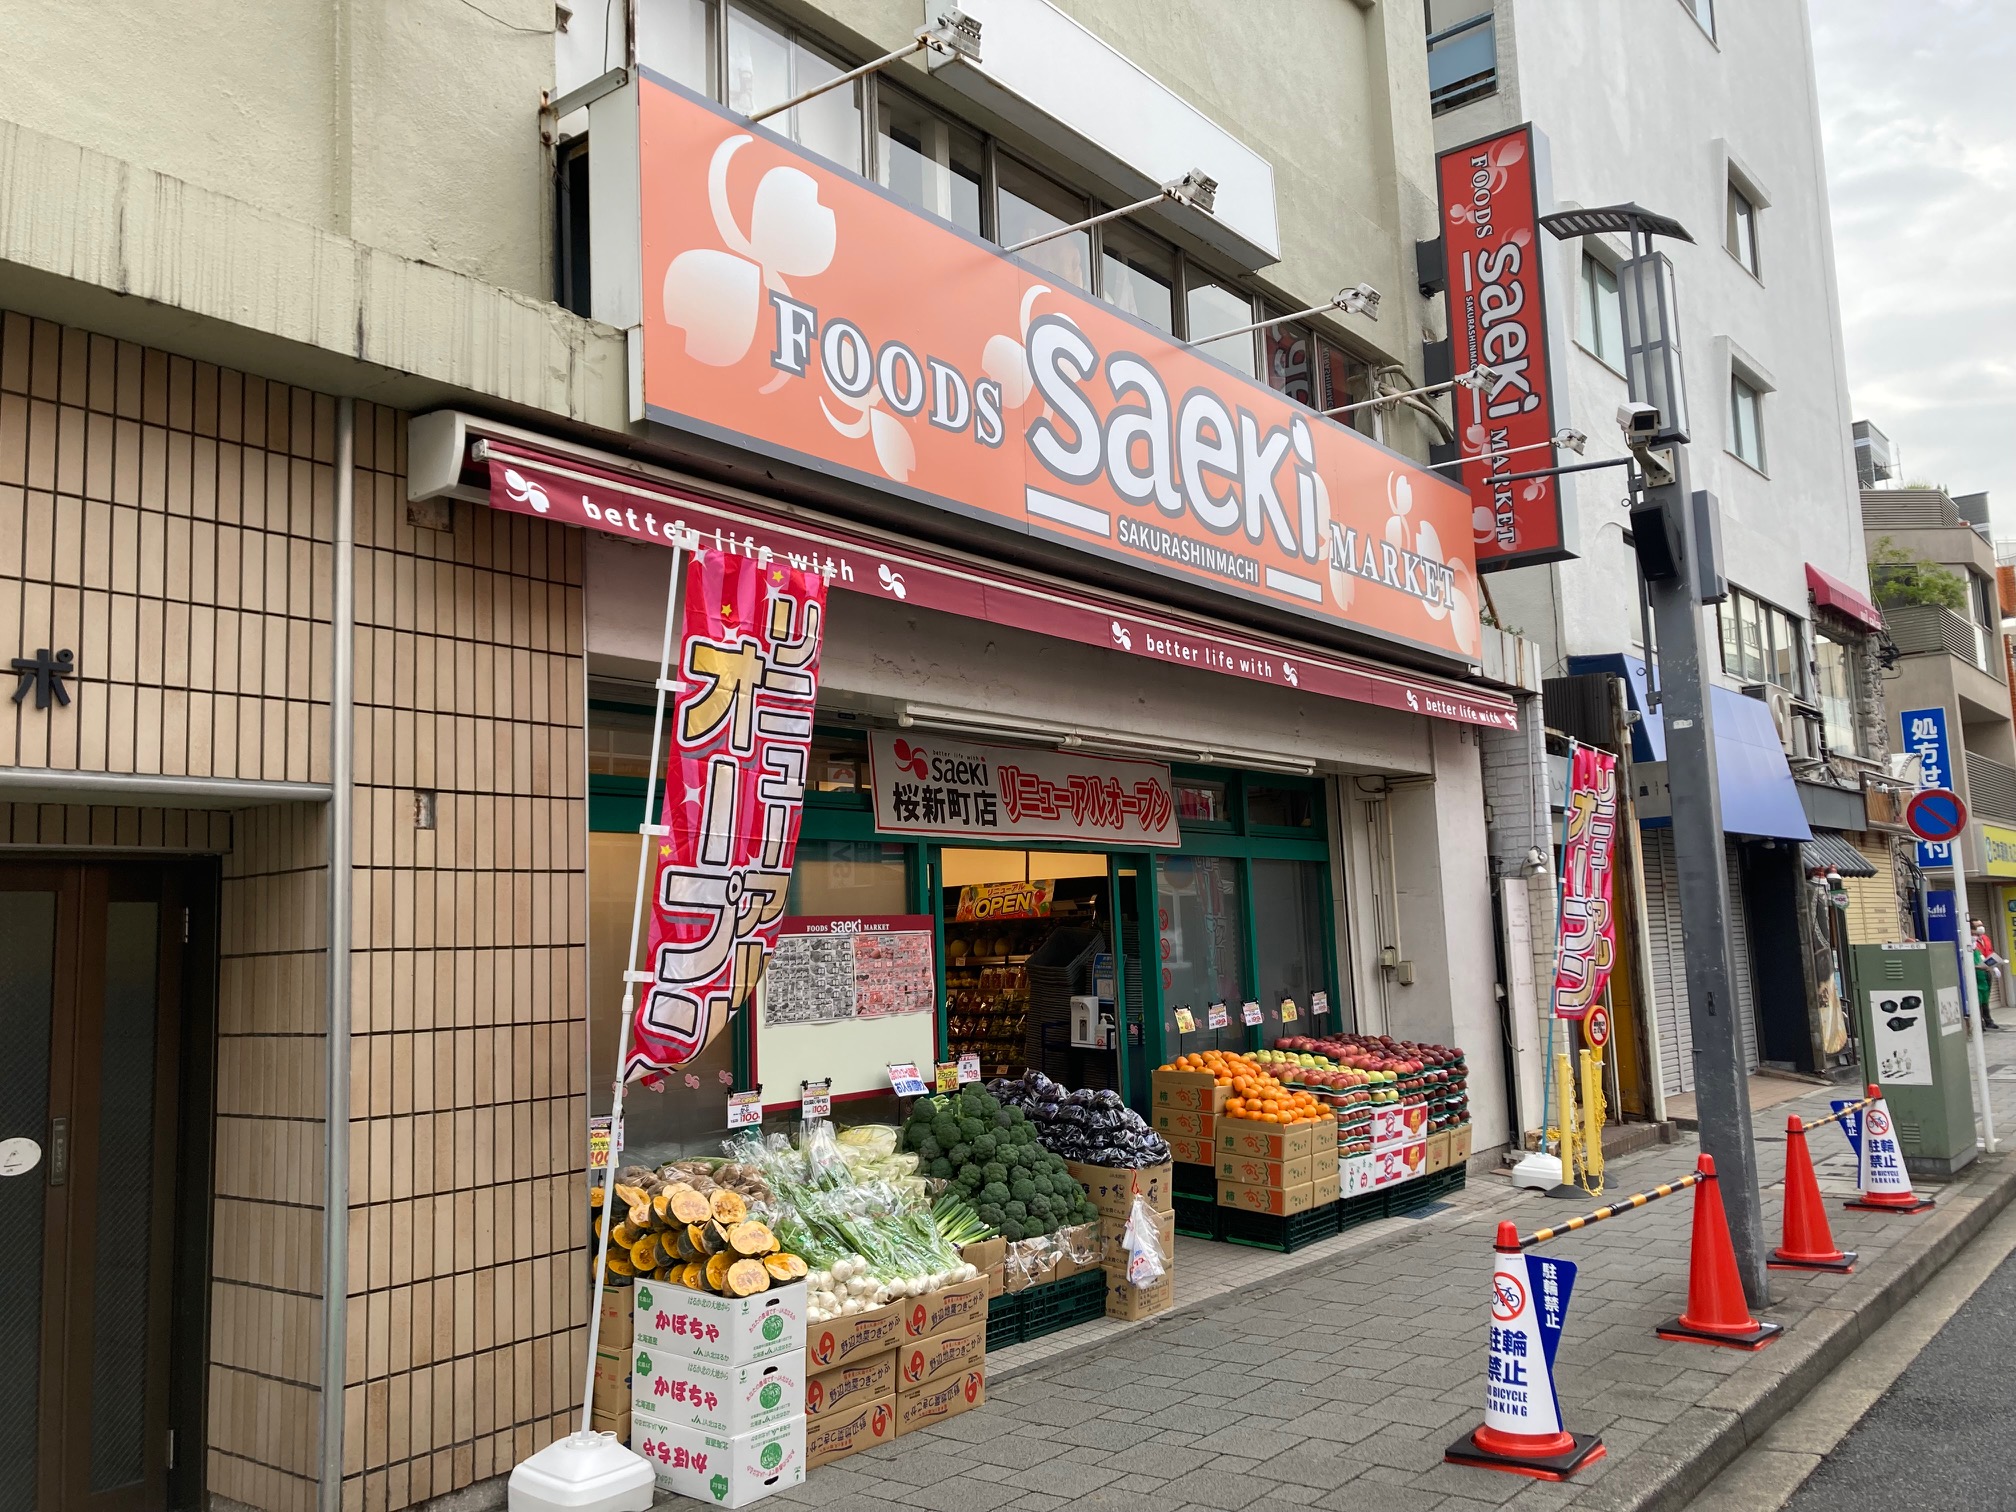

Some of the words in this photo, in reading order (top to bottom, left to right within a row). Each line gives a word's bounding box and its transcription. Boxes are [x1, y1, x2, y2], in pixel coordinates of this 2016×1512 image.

[1470, 152, 1494, 239] FOODS
[1465, 296, 1478, 370] SAKURASHINMAC
[770, 290, 1004, 448] FOODS
[1028, 314, 1322, 563] saeki
[1330, 524, 1455, 611] MARKET
[788, 551, 854, 583] with
[1118, 518, 1260, 584] SAKURASHINMACHI
[1146, 633, 1198, 661] better
[1205, 647, 1234, 670] life
[1240, 657, 1272, 678] with
[11, 648, 74, 709] ポ
[1426, 697, 1456, 715] better
[1460, 705, 1478, 720] life
[1479, 710, 1502, 723] with
[931, 756, 989, 787] saeki
[893, 781, 998, 828] 桜新町店
[997, 764, 1172, 833] リニューアルオープン
[974, 892, 1033, 919] OPEN
[987, 883, 1026, 896] リニューアル
[830, 918, 862, 933] saeki
[1928, 904, 1946, 914] sahi
[1868, 1139, 1895, 1153] 駐輪
[1870, 1154, 1898, 1168] 禁止
[655, 1309, 720, 1343] かぼちゃ
[653, 1375, 718, 1412] かぼちゃ
[1493, 1387, 1528, 1403] BICYCLE
[642, 1437, 708, 1474] かぼちゃ
